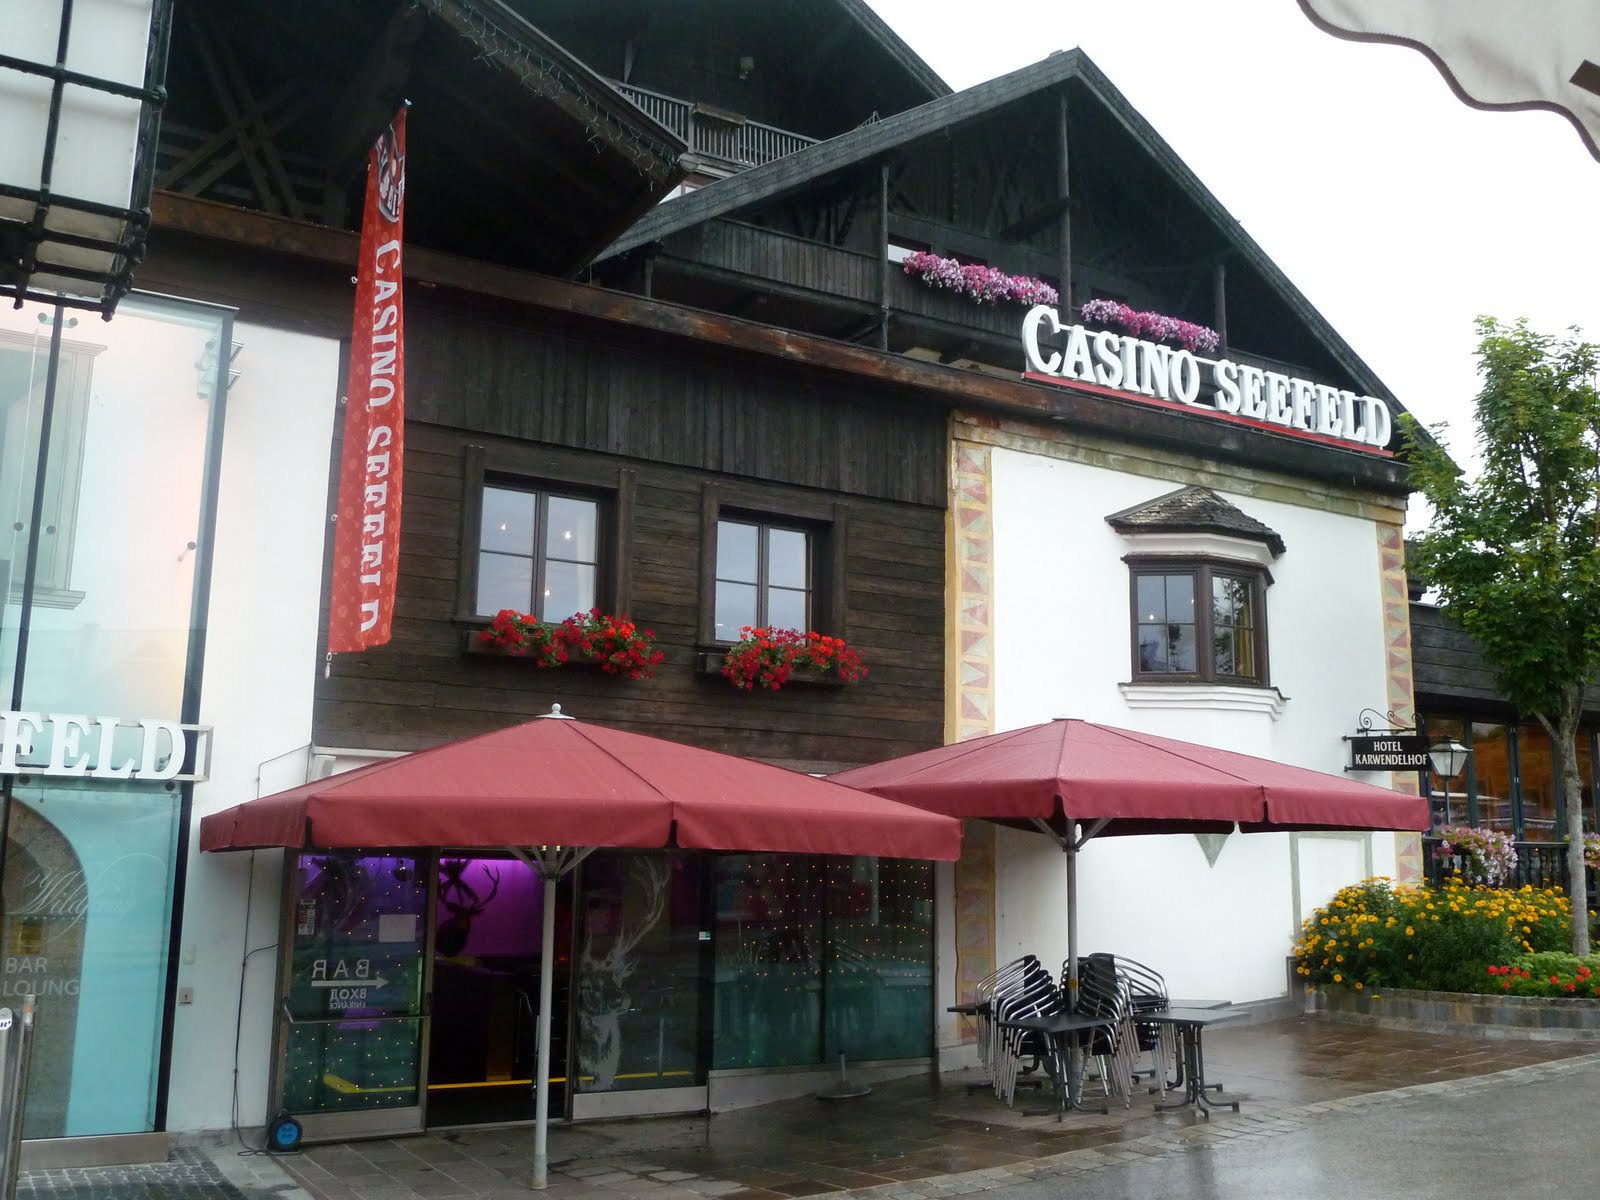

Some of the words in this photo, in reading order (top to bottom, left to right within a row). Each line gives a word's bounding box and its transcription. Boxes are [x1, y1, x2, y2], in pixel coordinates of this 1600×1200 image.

[369, 239, 401, 407] CASINO
[1021, 304, 1200, 405] CASINO
[1213, 358, 1393, 449] SEEFELD
[0, 710, 187, 781] FELD
[1355, 753, 1428, 765] KARWENDELHOF
[1373, 741, 1403, 752] HOTEL
[5, 956, 49, 974] BAR
